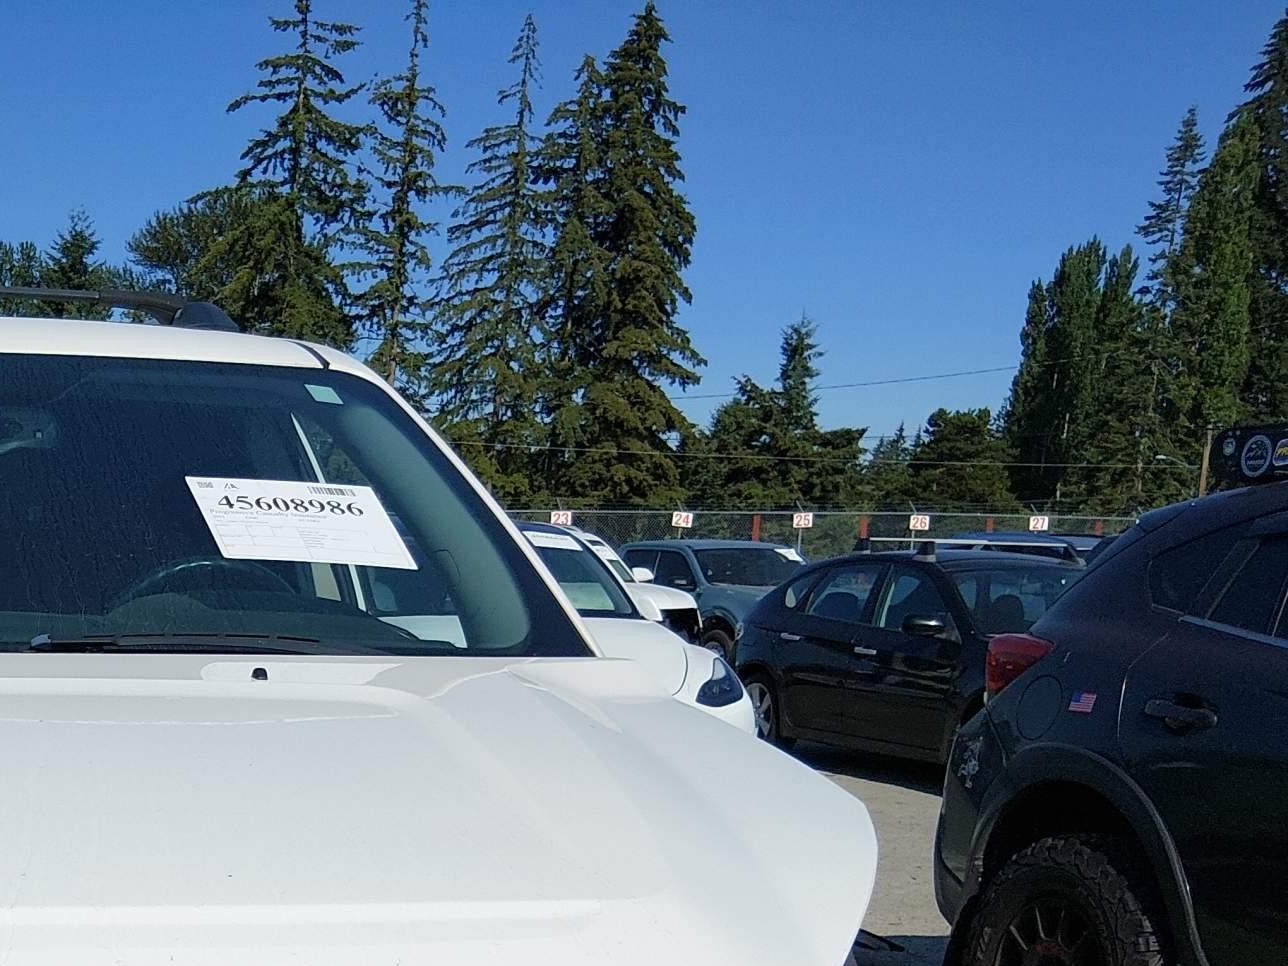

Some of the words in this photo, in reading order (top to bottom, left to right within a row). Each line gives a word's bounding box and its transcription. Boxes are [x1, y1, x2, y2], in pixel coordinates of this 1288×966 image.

[217, 495, 364, 516] 45608986
[552, 512, 569, 526] 23
[674, 513, 690, 527] 24
[795, 514, 810, 527] 25
[911, 516, 927, 529] 26
[1032, 517, 1046, 529] 27
